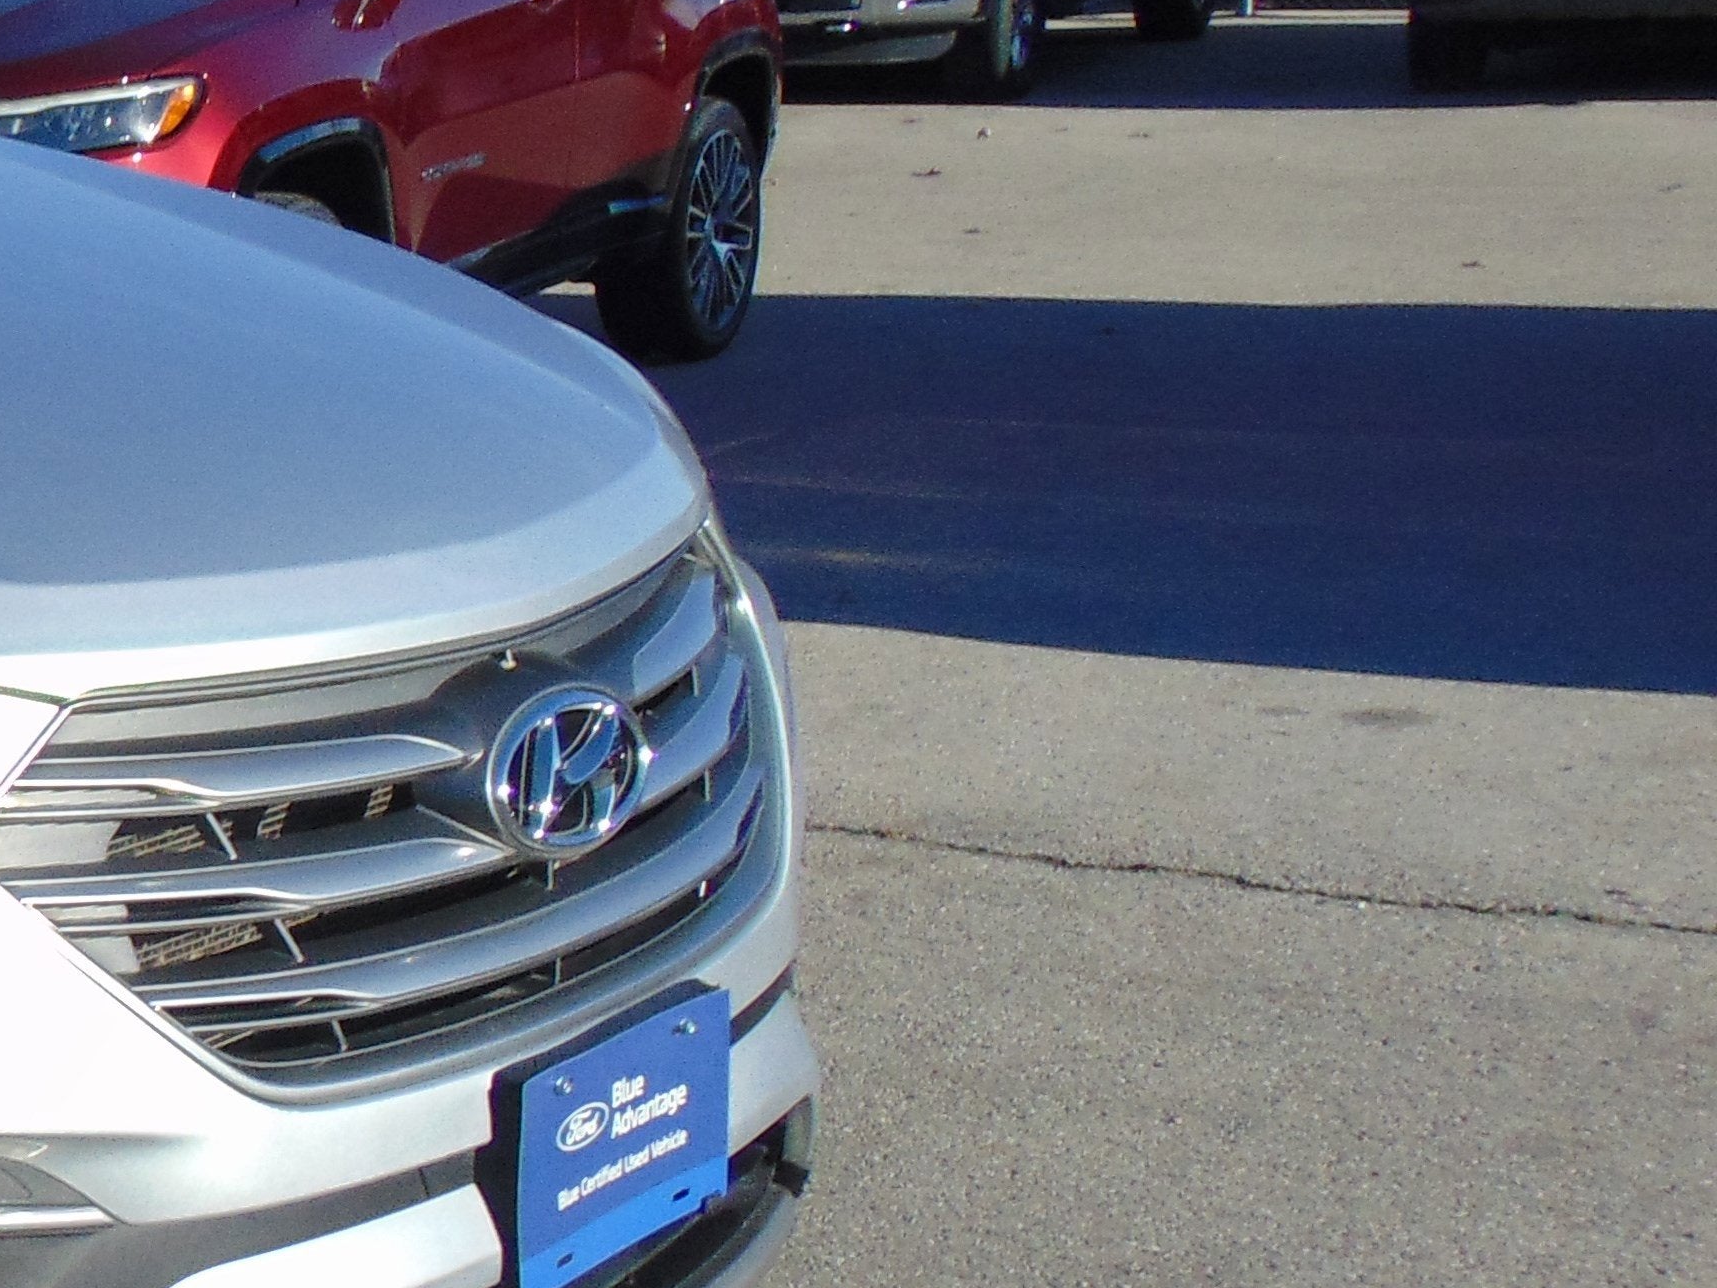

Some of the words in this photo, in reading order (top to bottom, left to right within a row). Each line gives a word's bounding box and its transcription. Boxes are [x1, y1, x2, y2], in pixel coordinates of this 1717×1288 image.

[610, 1083, 688, 1139] Advantage
[611, 1074, 645, 1108] Blue
[557, 1184, 581, 1211] Blue
[624, 1143, 651, 1174] Used
[651, 1129, 689, 1159] Vehicle
